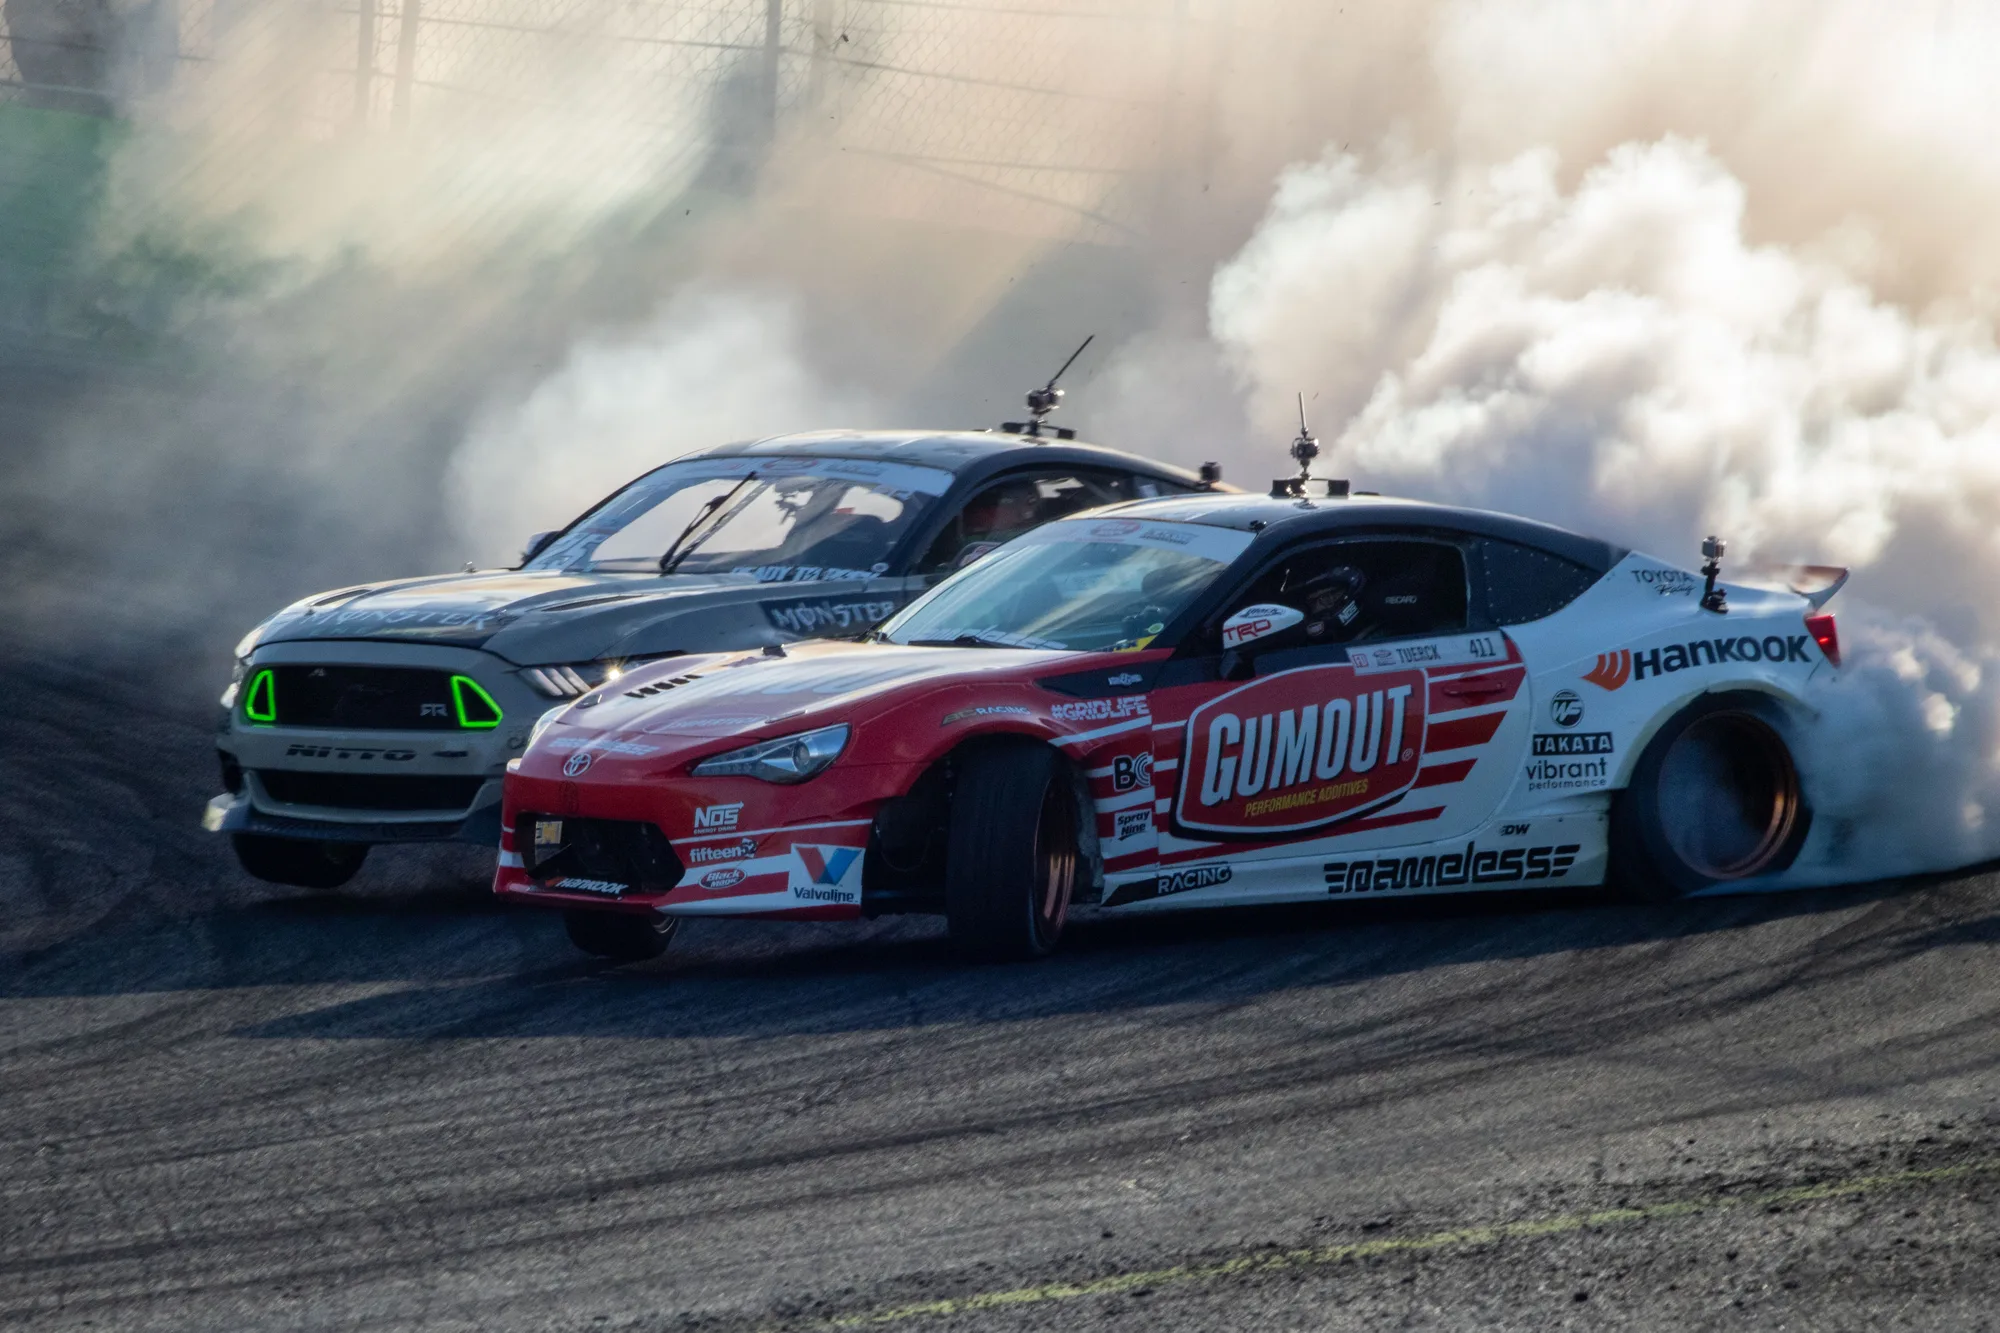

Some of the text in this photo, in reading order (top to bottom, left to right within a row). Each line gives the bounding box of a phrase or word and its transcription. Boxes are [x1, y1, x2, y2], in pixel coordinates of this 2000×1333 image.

[1632, 570, 1694, 583] TOYOTA
[1223, 619, 1271, 641] TRD
[1396, 644, 1441, 664] TUERCK
[1469, 637, 1496, 657] 411
[976, 706, 1031, 716] RACING
[1051, 696, 1149, 721] #GRIDLIFE
[286, 744, 417, 761] NITTO
[1201, 684, 1412, 806] GUMOUT
[1534, 735, 1612, 753] TAKATA
[1526, 757, 1607, 780] vibrant
[1529, 778, 1607, 792] performance
[1244, 778, 1369, 818] PERFORMANCE ADDITIVES
[694, 801, 744, 828] NOS
[1117, 811, 1150, 825] Spray
[1121, 823, 1146, 836] Nine
[706, 871, 740, 882] Black
[710, 878, 737, 888] Magic
[1157, 867, 1232, 893] RACING
[793, 886, 855, 903] Valvoline
